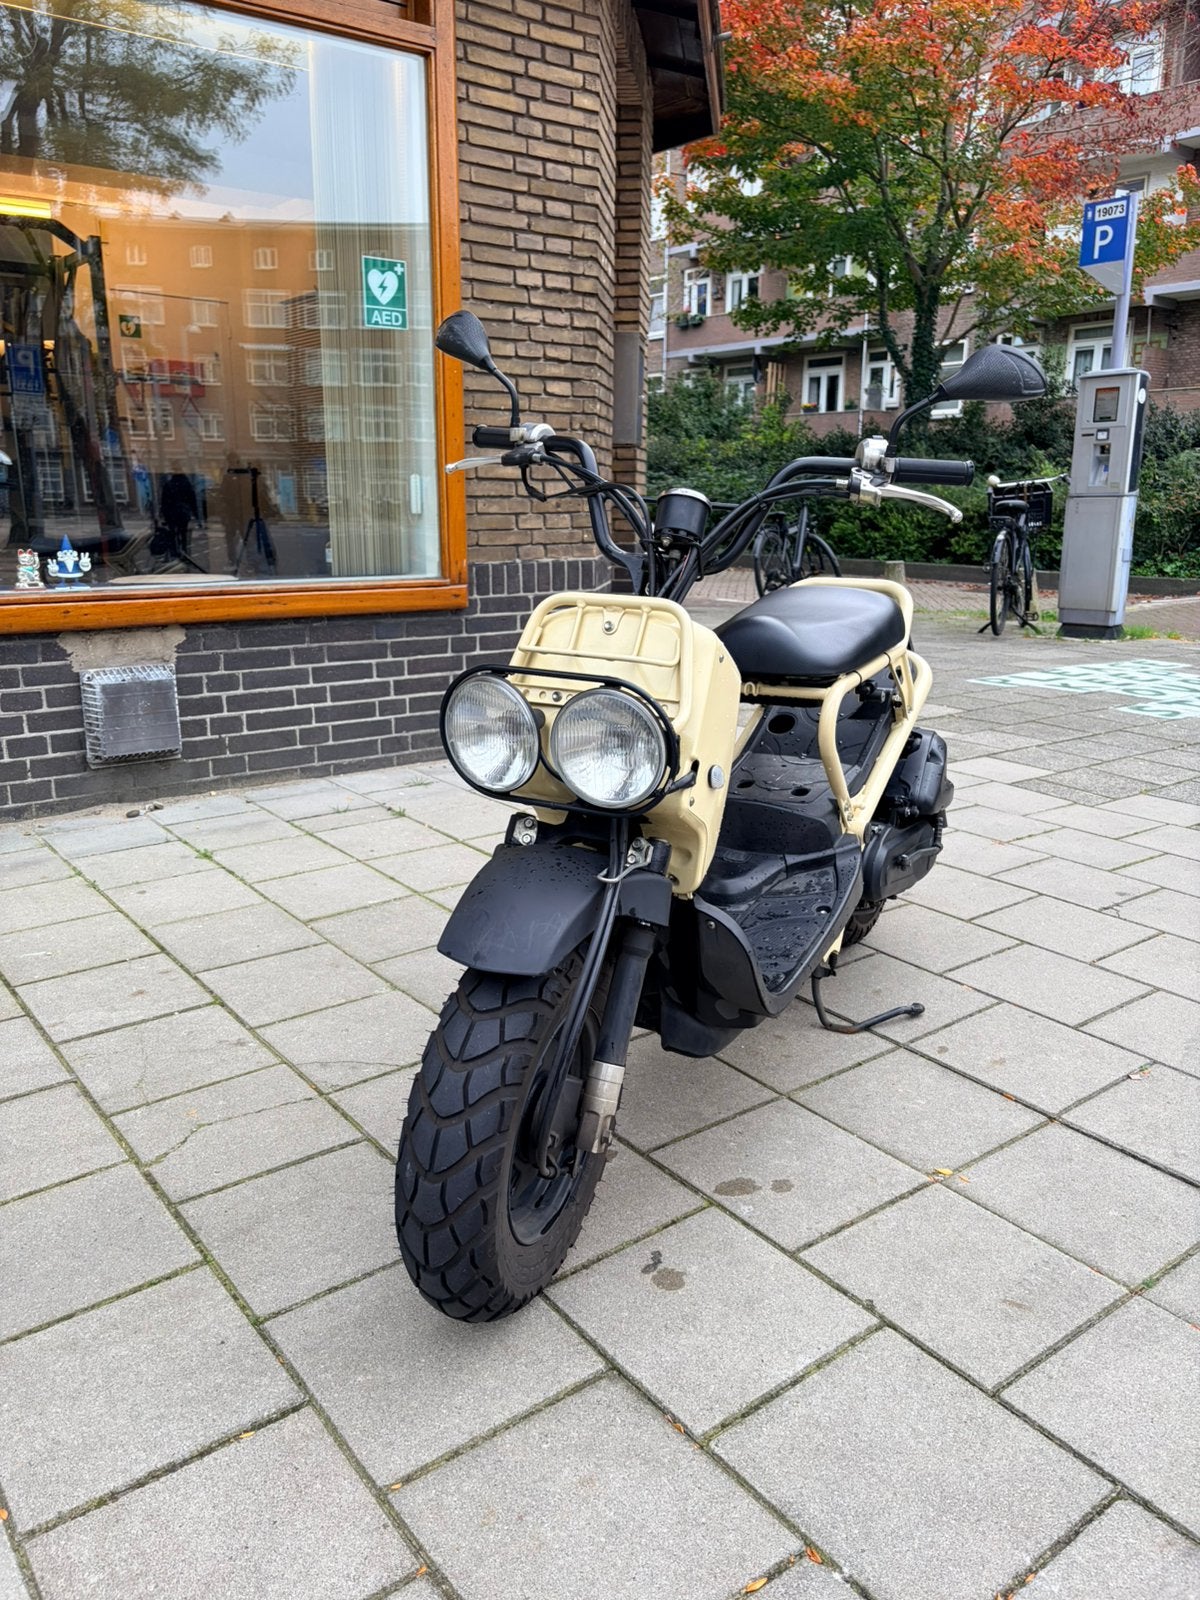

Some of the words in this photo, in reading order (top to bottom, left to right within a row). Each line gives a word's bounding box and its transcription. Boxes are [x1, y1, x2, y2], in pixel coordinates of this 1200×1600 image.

[1097, 204, 1125, 218] 19073
[1093, 225, 1114, 259] P
[371, 310, 402, 326] AED
[977, 660, 1179, 686] PLEASE
